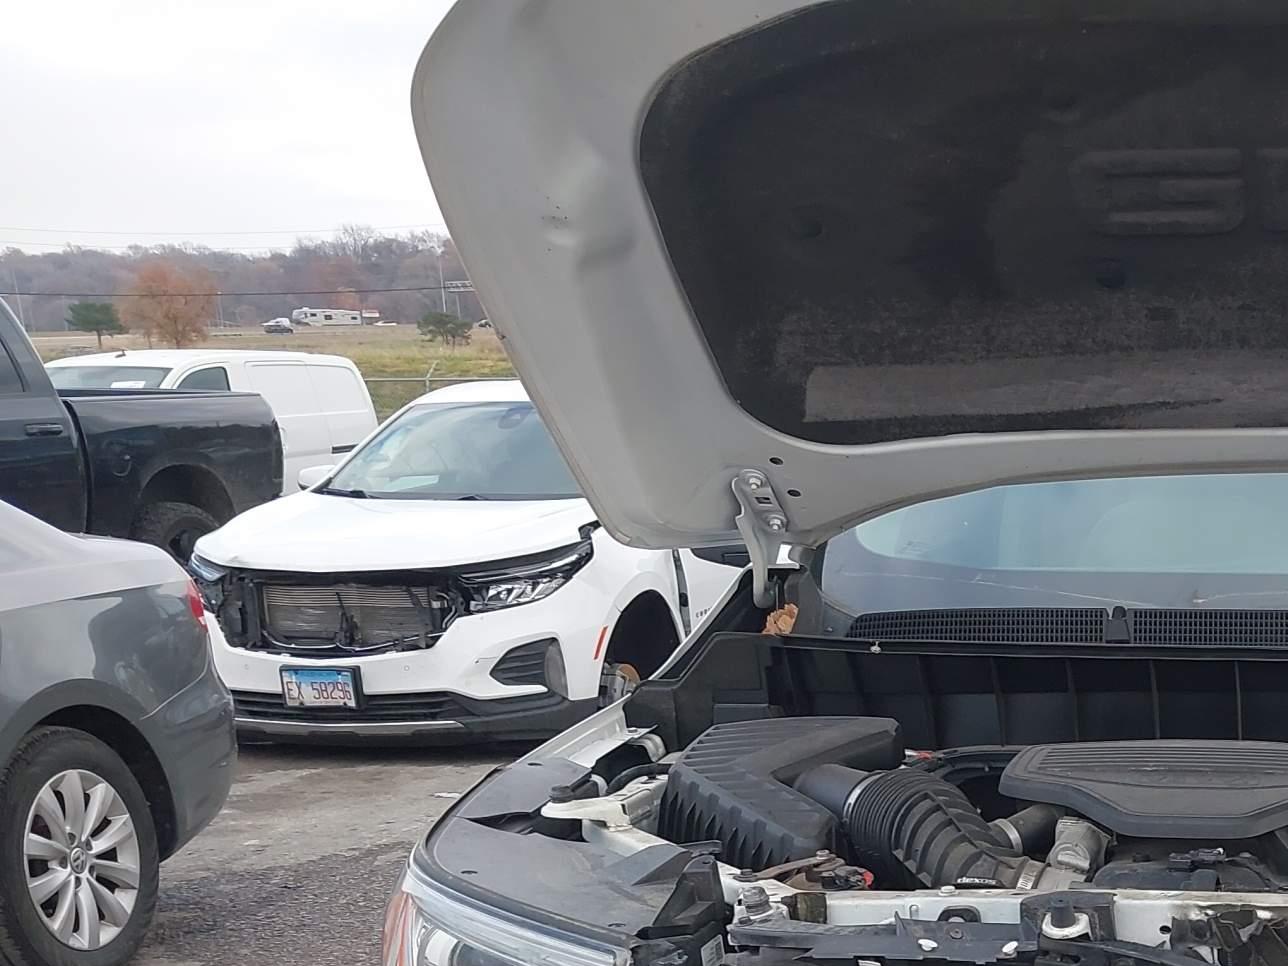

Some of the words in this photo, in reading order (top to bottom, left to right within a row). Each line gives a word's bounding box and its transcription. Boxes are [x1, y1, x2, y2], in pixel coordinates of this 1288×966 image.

[286, 681, 304, 700] EX
[311, 681, 352, 700] 58296
[956, 877, 997, 885] dexos
